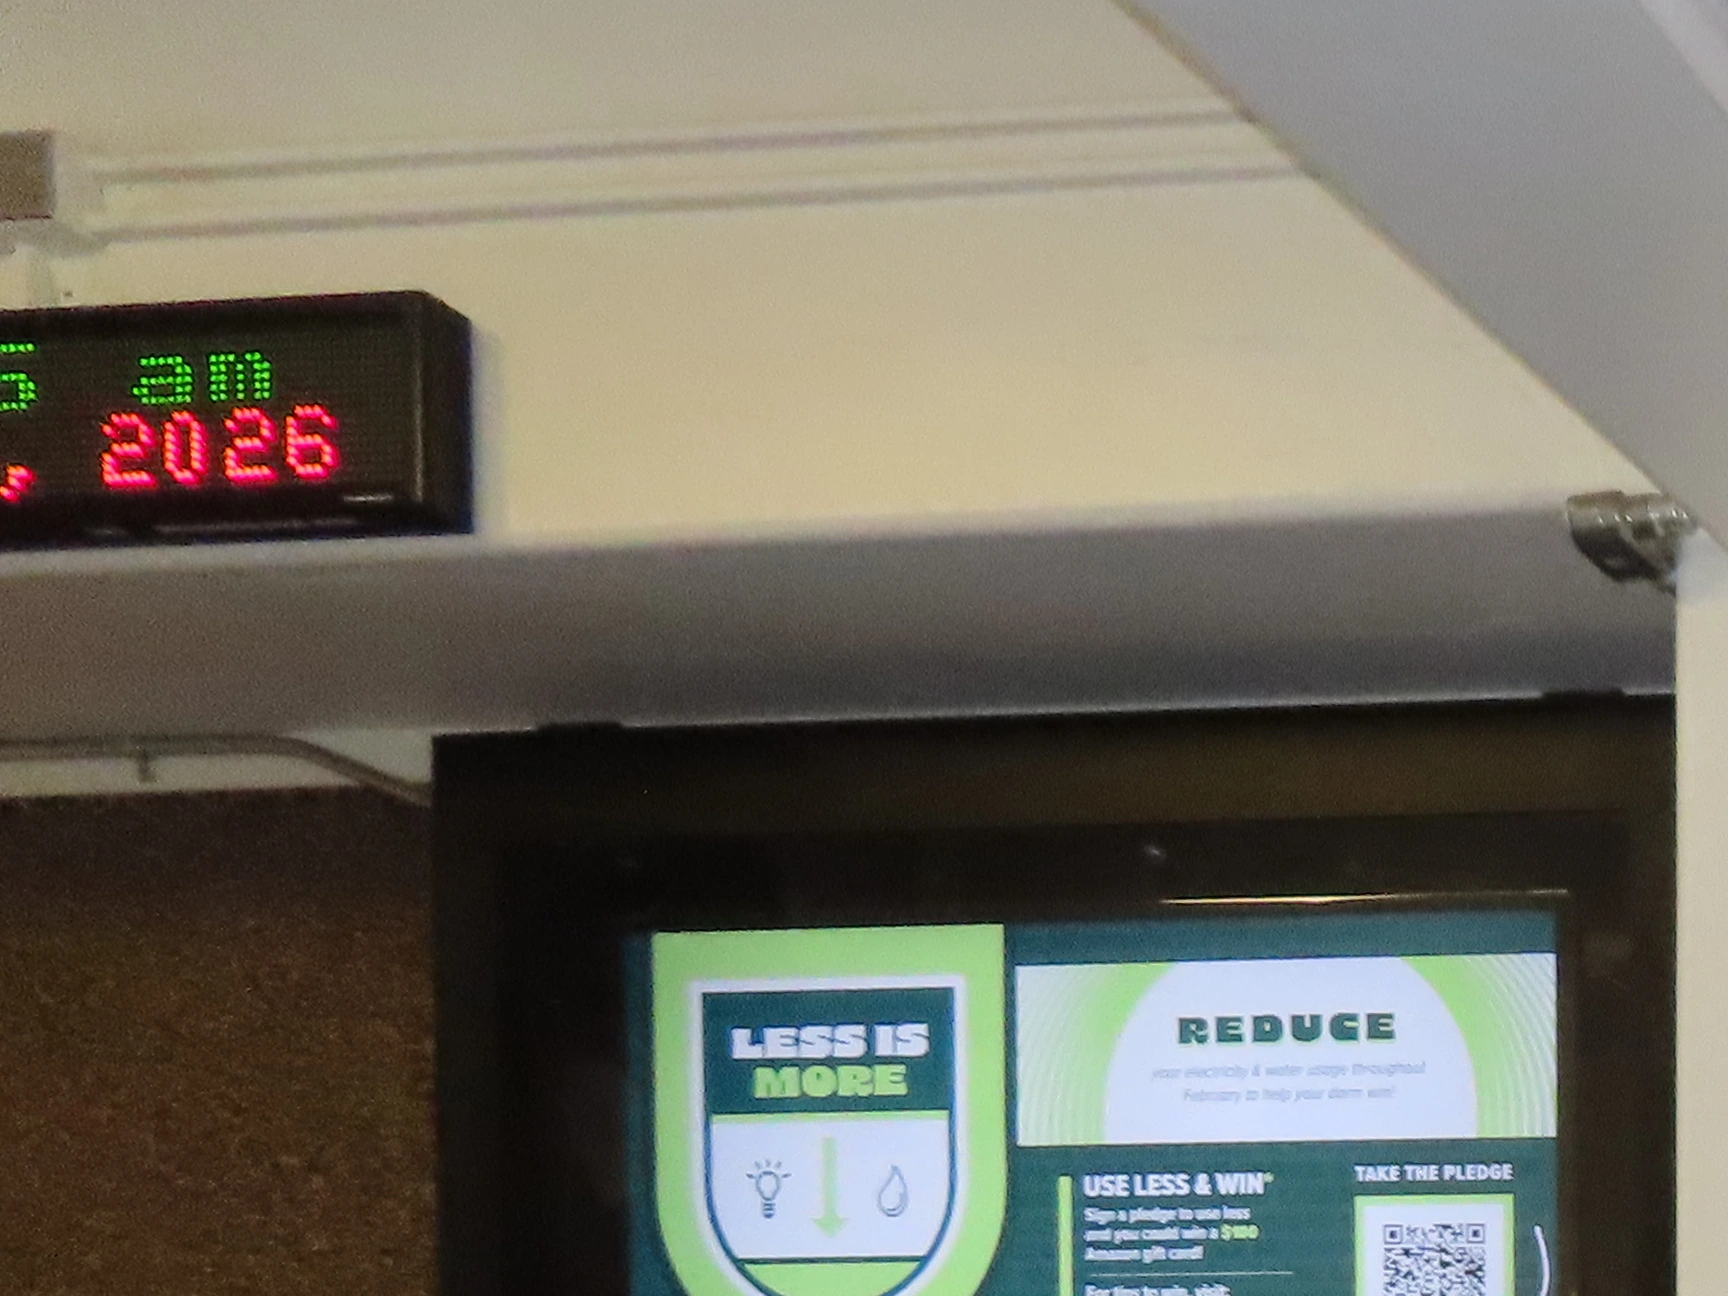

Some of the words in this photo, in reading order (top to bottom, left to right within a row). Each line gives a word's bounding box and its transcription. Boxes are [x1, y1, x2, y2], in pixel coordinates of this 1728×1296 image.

[132, 351, 273, 406] am
[100, 403, 340, 490] 2026
[731, 1023, 869, 1060] LESS
[873, 1022, 931, 1058] IS
[1176, 1012, 1397, 1045] REDUCE
[753, 1063, 909, 1099] MORE
[1083, 1173, 1131, 1198] USE
[1133, 1172, 1192, 1197] LESS
[1193, 1173, 1212, 1196] &
[1353, 1164, 1401, 1182] TAKE
[1403, 1163, 1440, 1182] THE
[1443, 1162, 1515, 1181] PLEDGE
